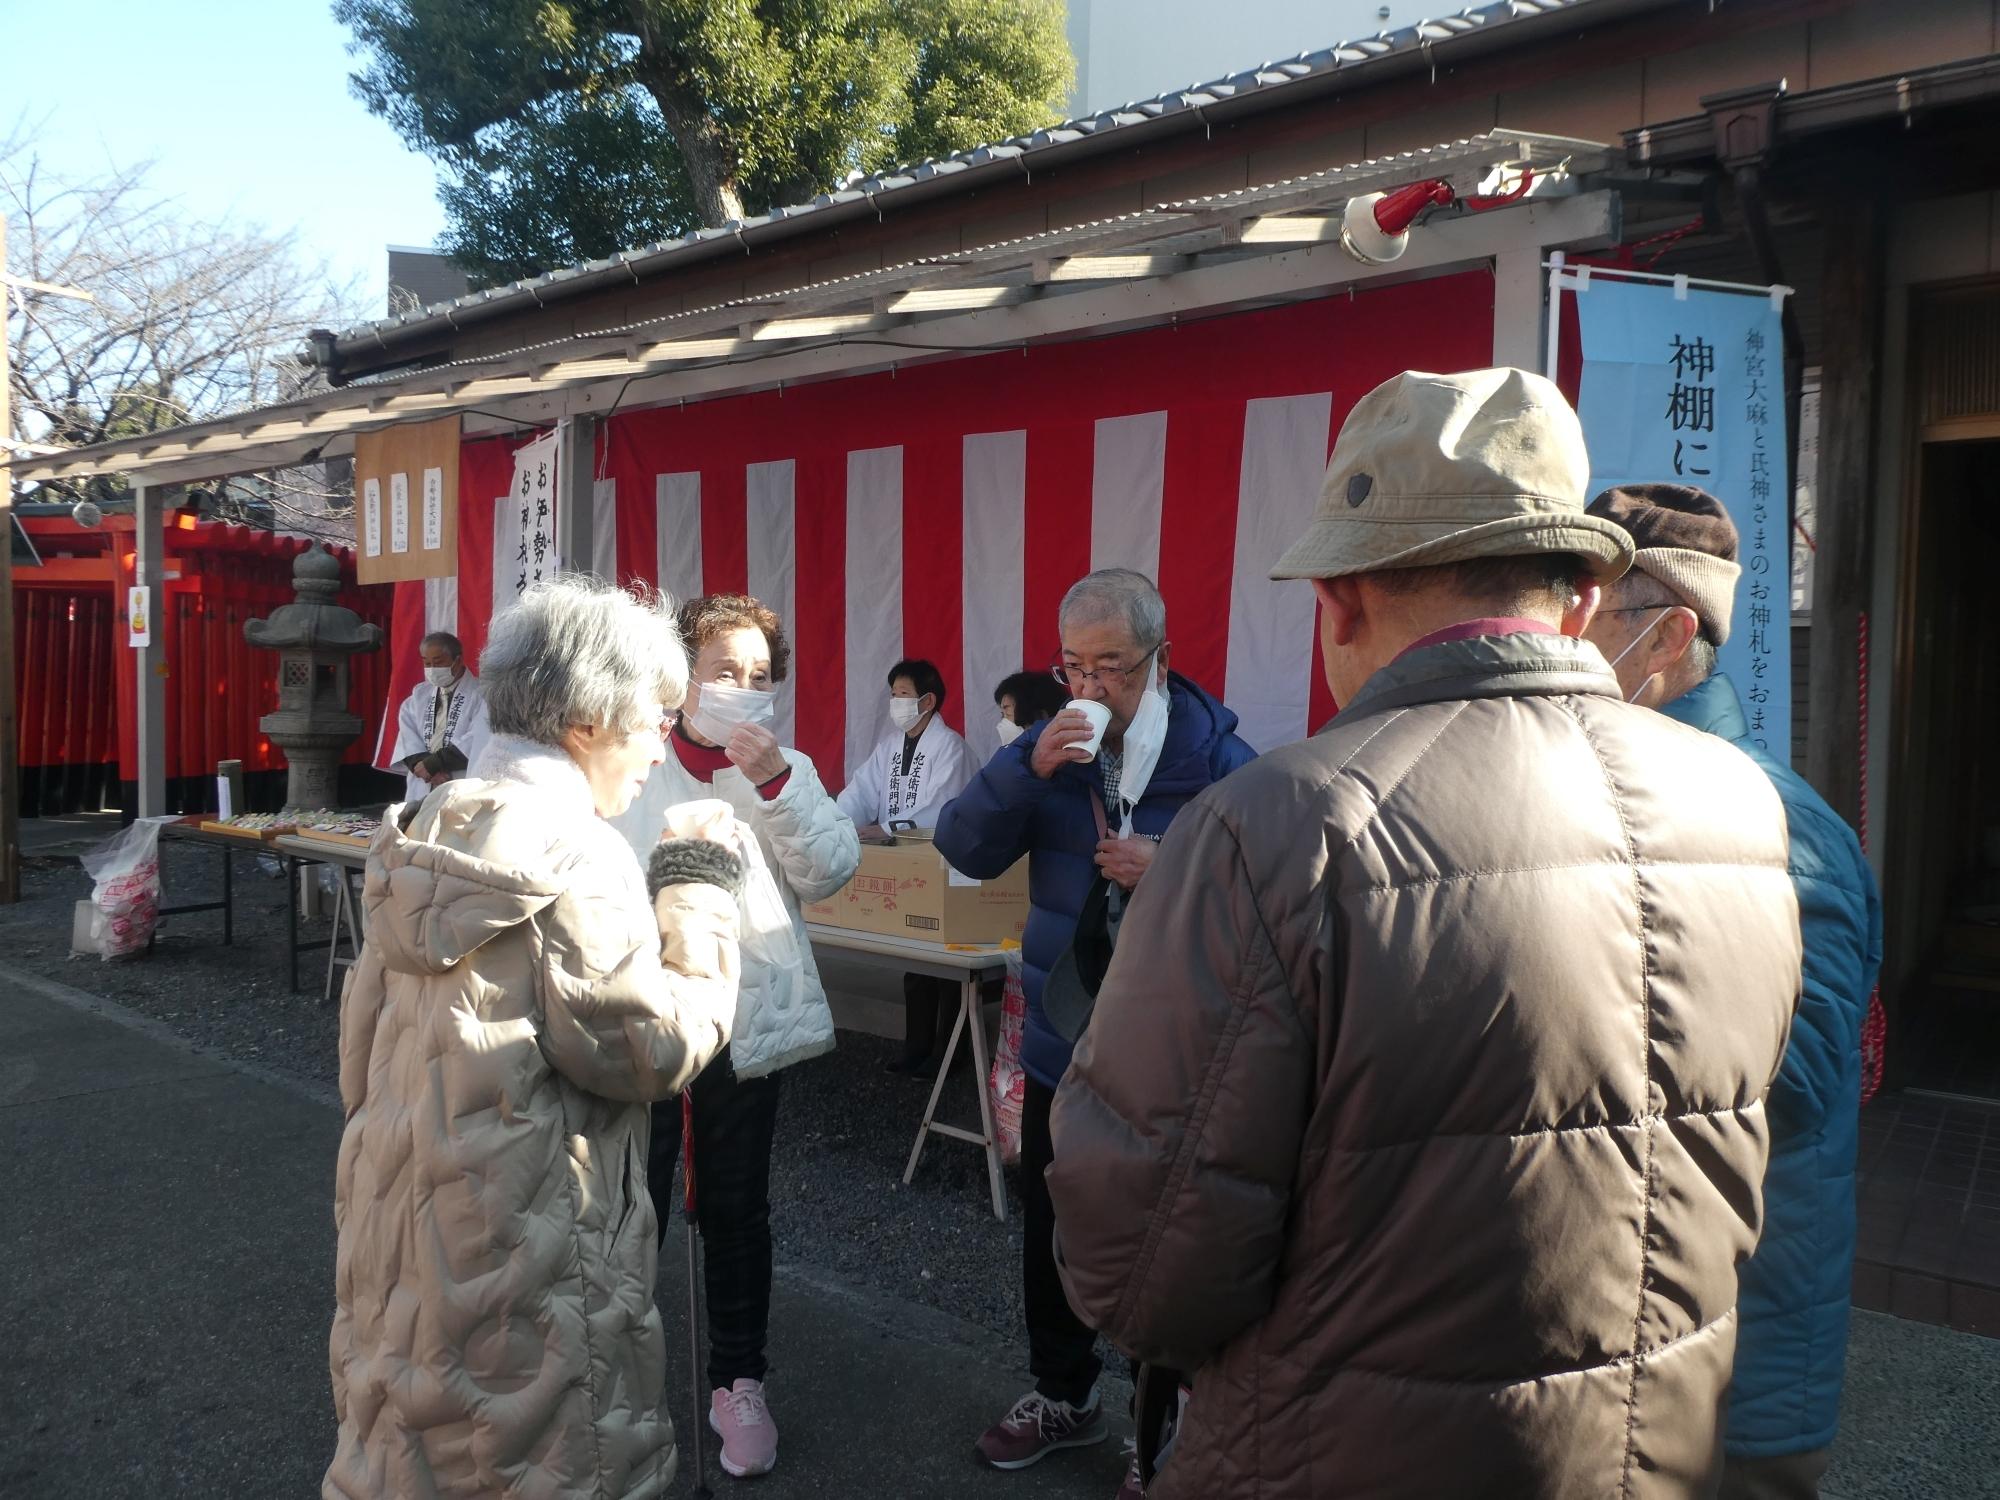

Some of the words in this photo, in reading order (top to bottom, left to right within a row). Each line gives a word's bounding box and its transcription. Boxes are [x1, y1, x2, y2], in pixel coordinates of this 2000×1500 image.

[1665, 333, 1715, 476] 神棚に
[906, 752, 926, 808] 紀左衛門
